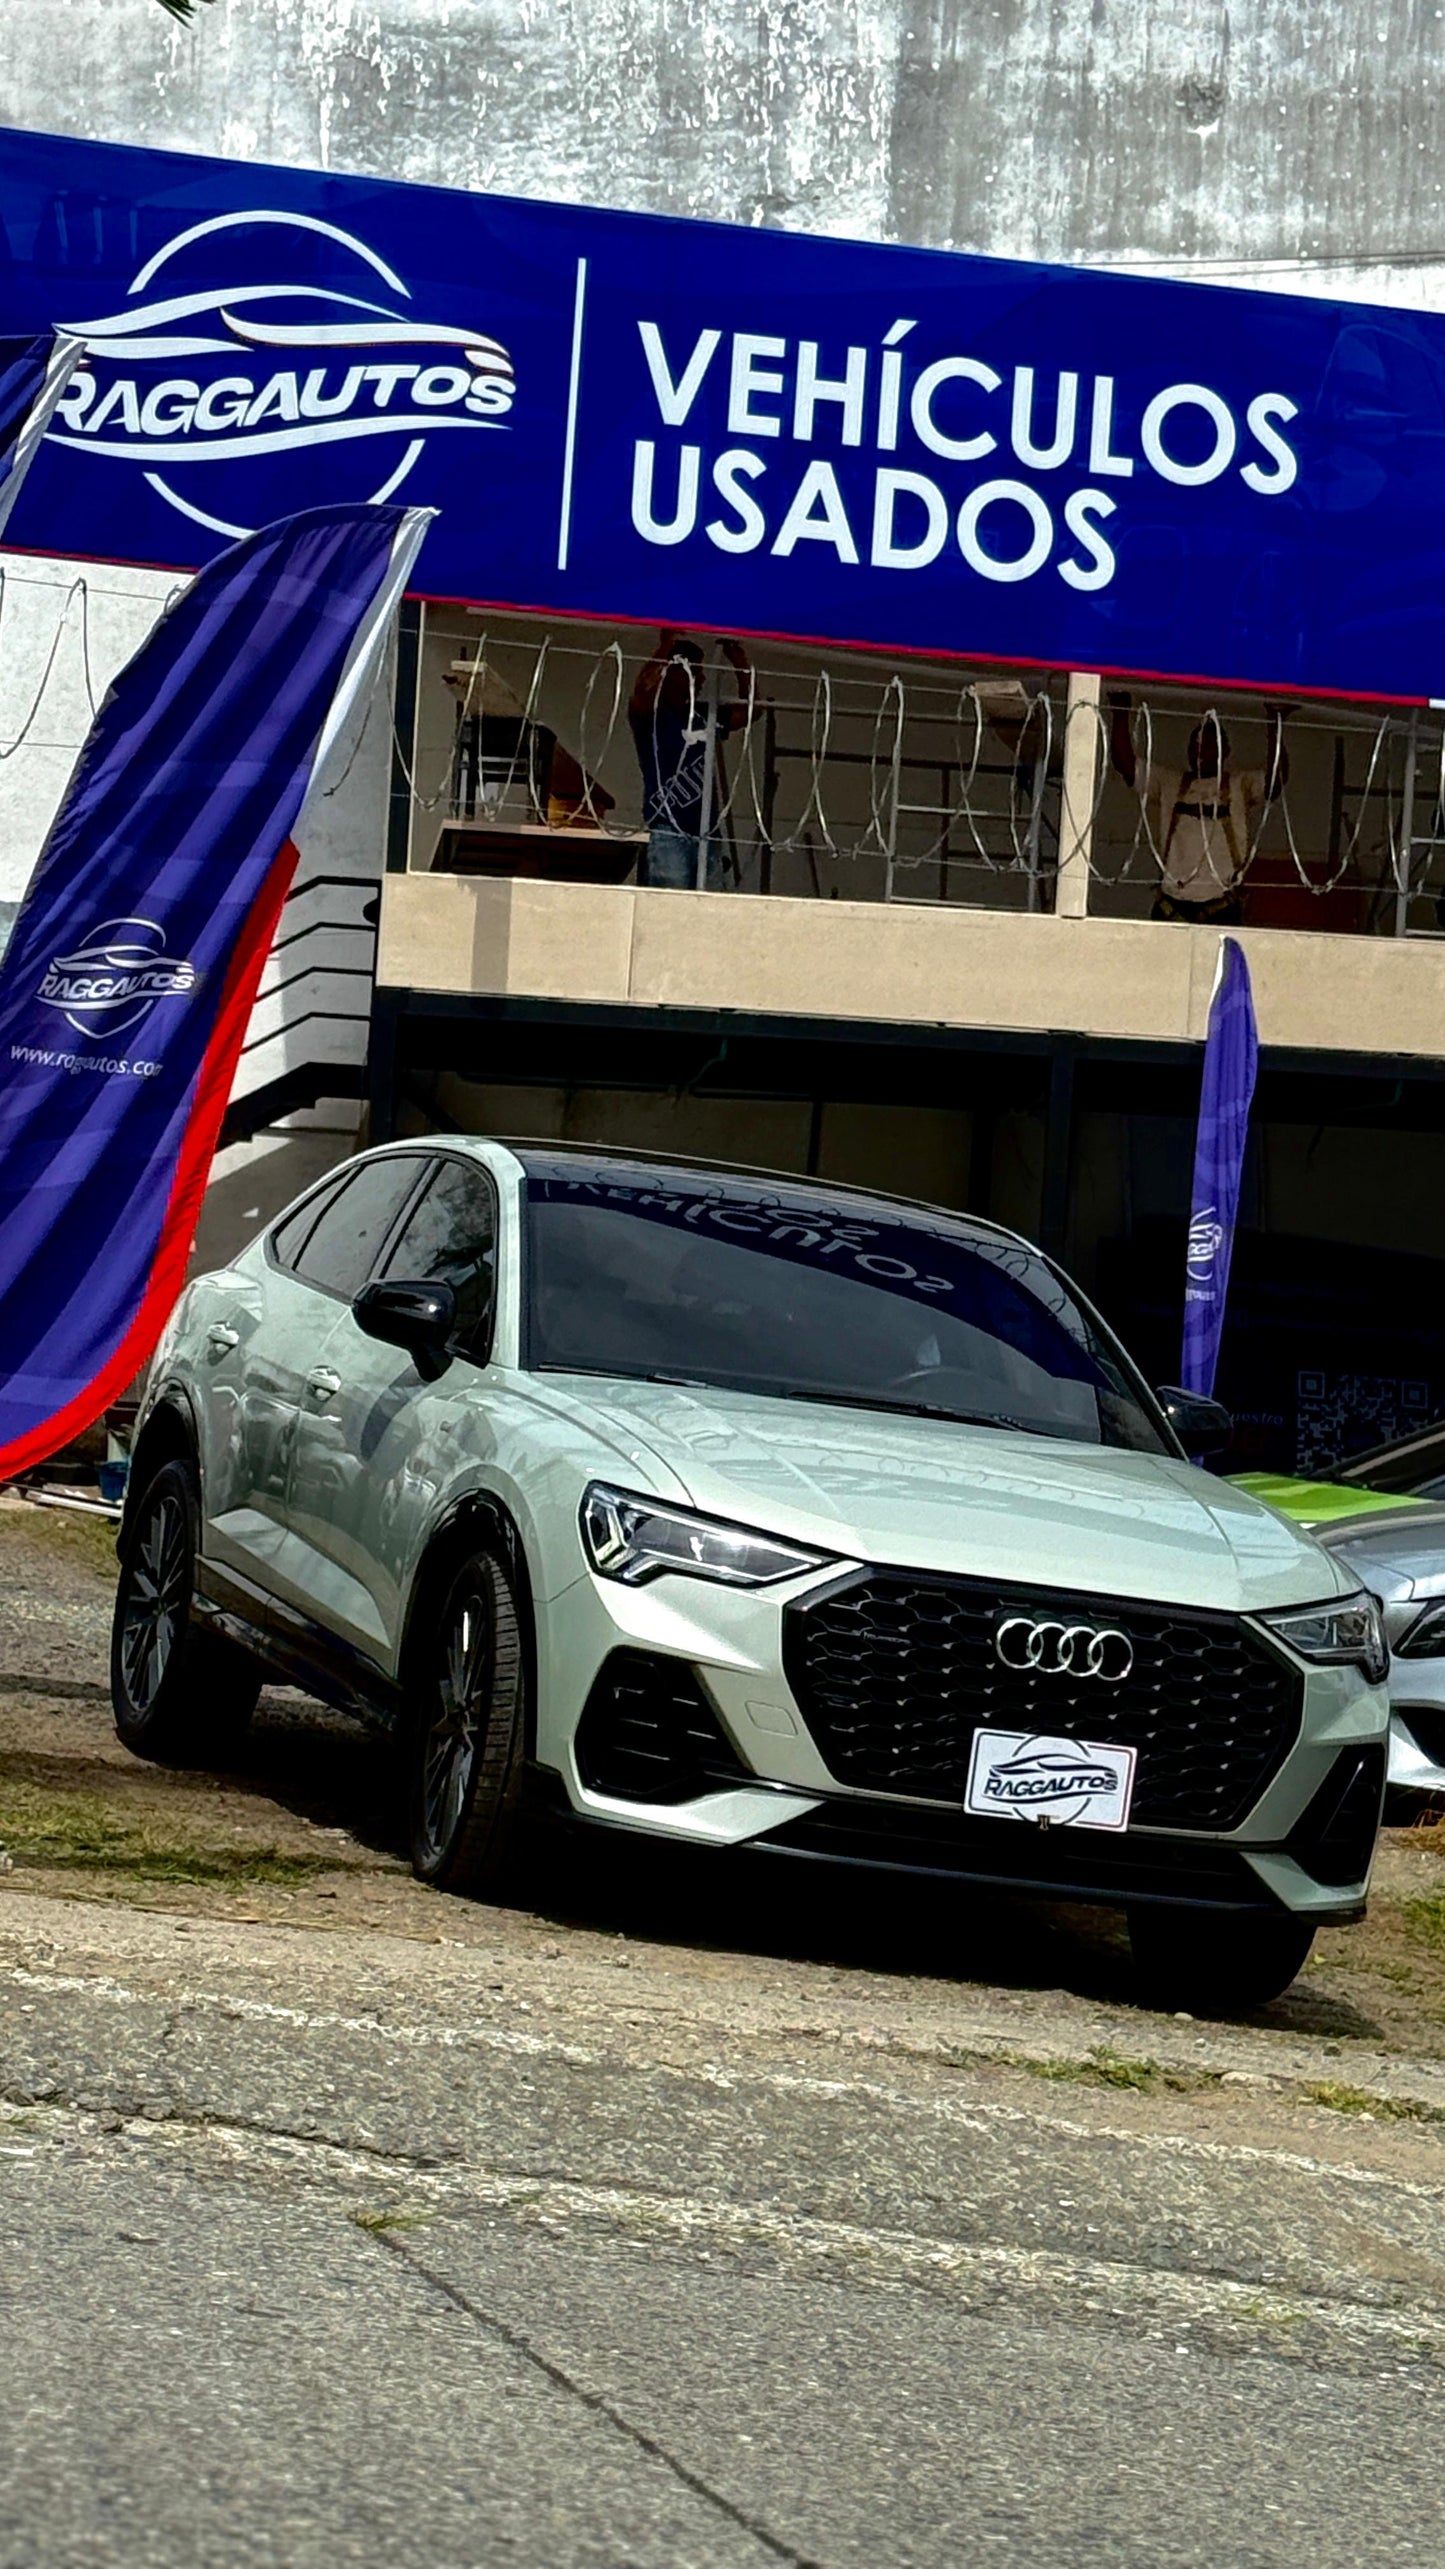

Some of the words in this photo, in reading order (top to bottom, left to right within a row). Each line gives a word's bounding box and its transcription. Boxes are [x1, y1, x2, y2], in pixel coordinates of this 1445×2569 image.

[54, 364, 516, 436] RAGGAUTOS
[638, 319, 1299, 496] VEHÍCULOS
[631, 440, 1117, 591] USADOS
[37, 973, 195, 999] RAGGAUTOS
[983, 1776, 1118, 1797] RAGGAUTOS
